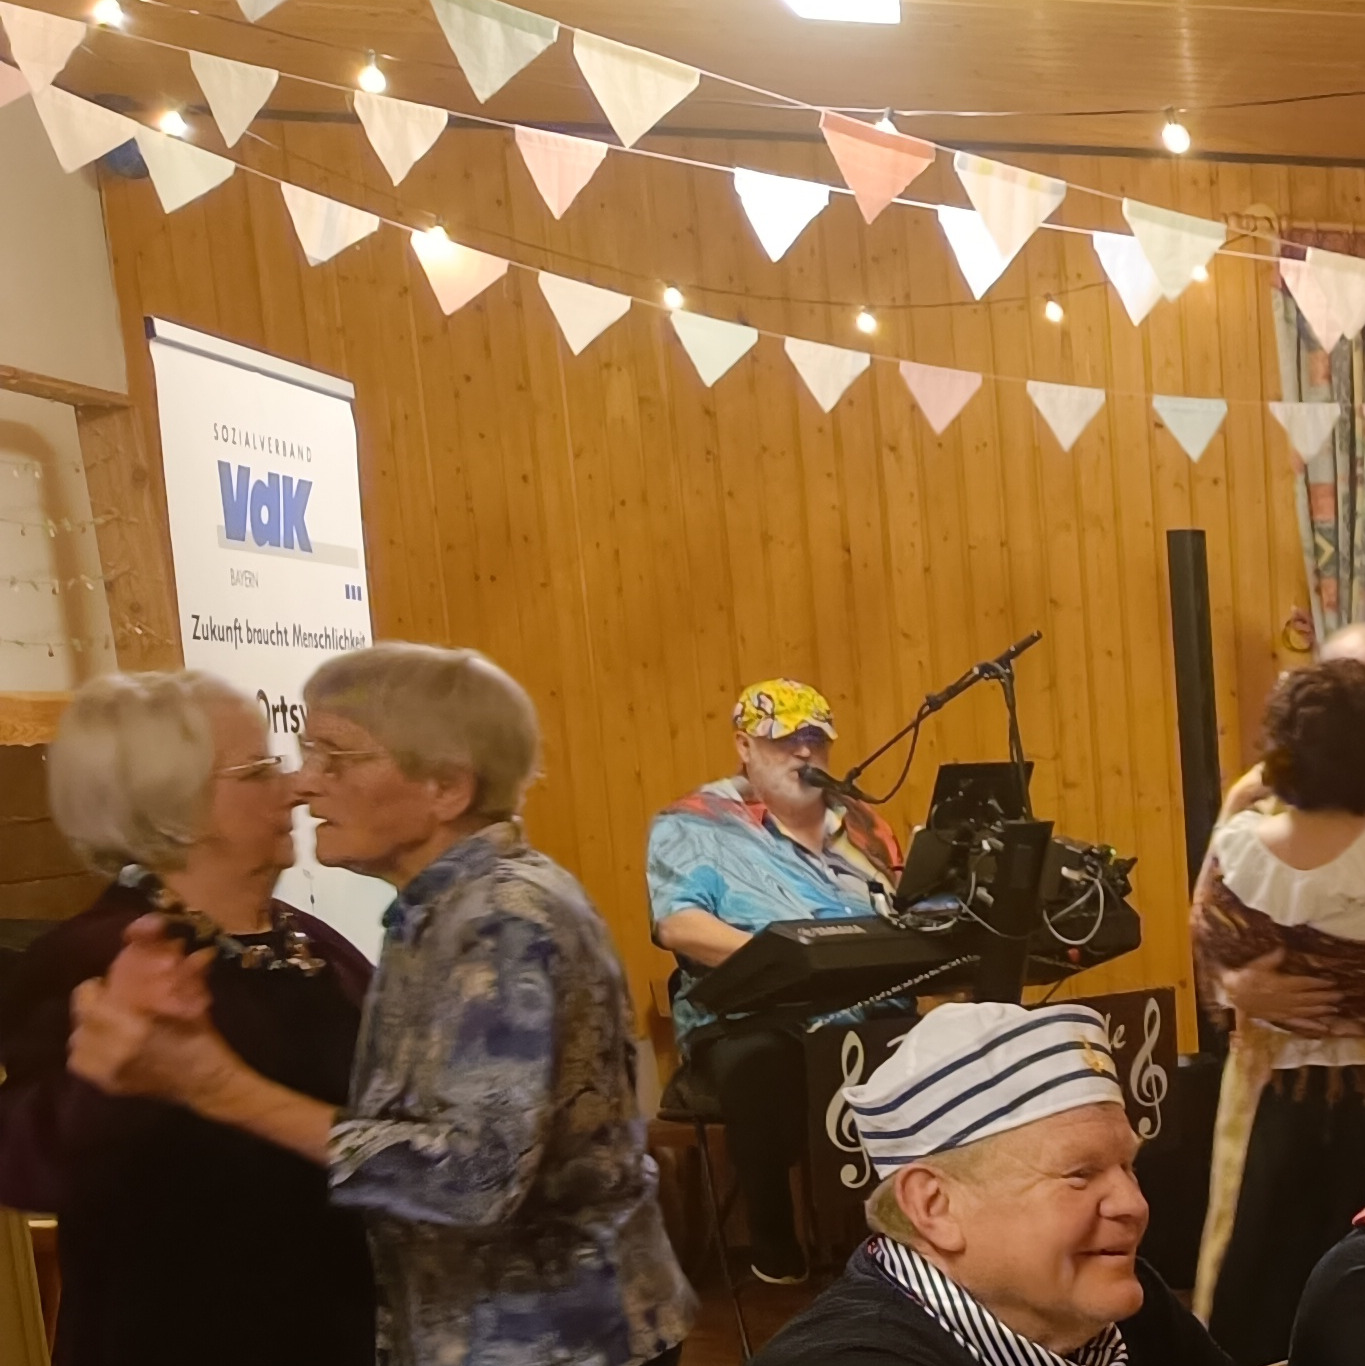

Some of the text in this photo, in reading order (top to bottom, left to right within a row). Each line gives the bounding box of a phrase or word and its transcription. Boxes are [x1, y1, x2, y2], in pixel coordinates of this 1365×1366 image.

[213, 422, 312, 463] SOZIALVERBAND
[217, 460, 313, 553] VdK
[229, 567, 260, 589] BAYERN
[191, 614, 366, 651] Zukunft braucht Menschlichkeit
